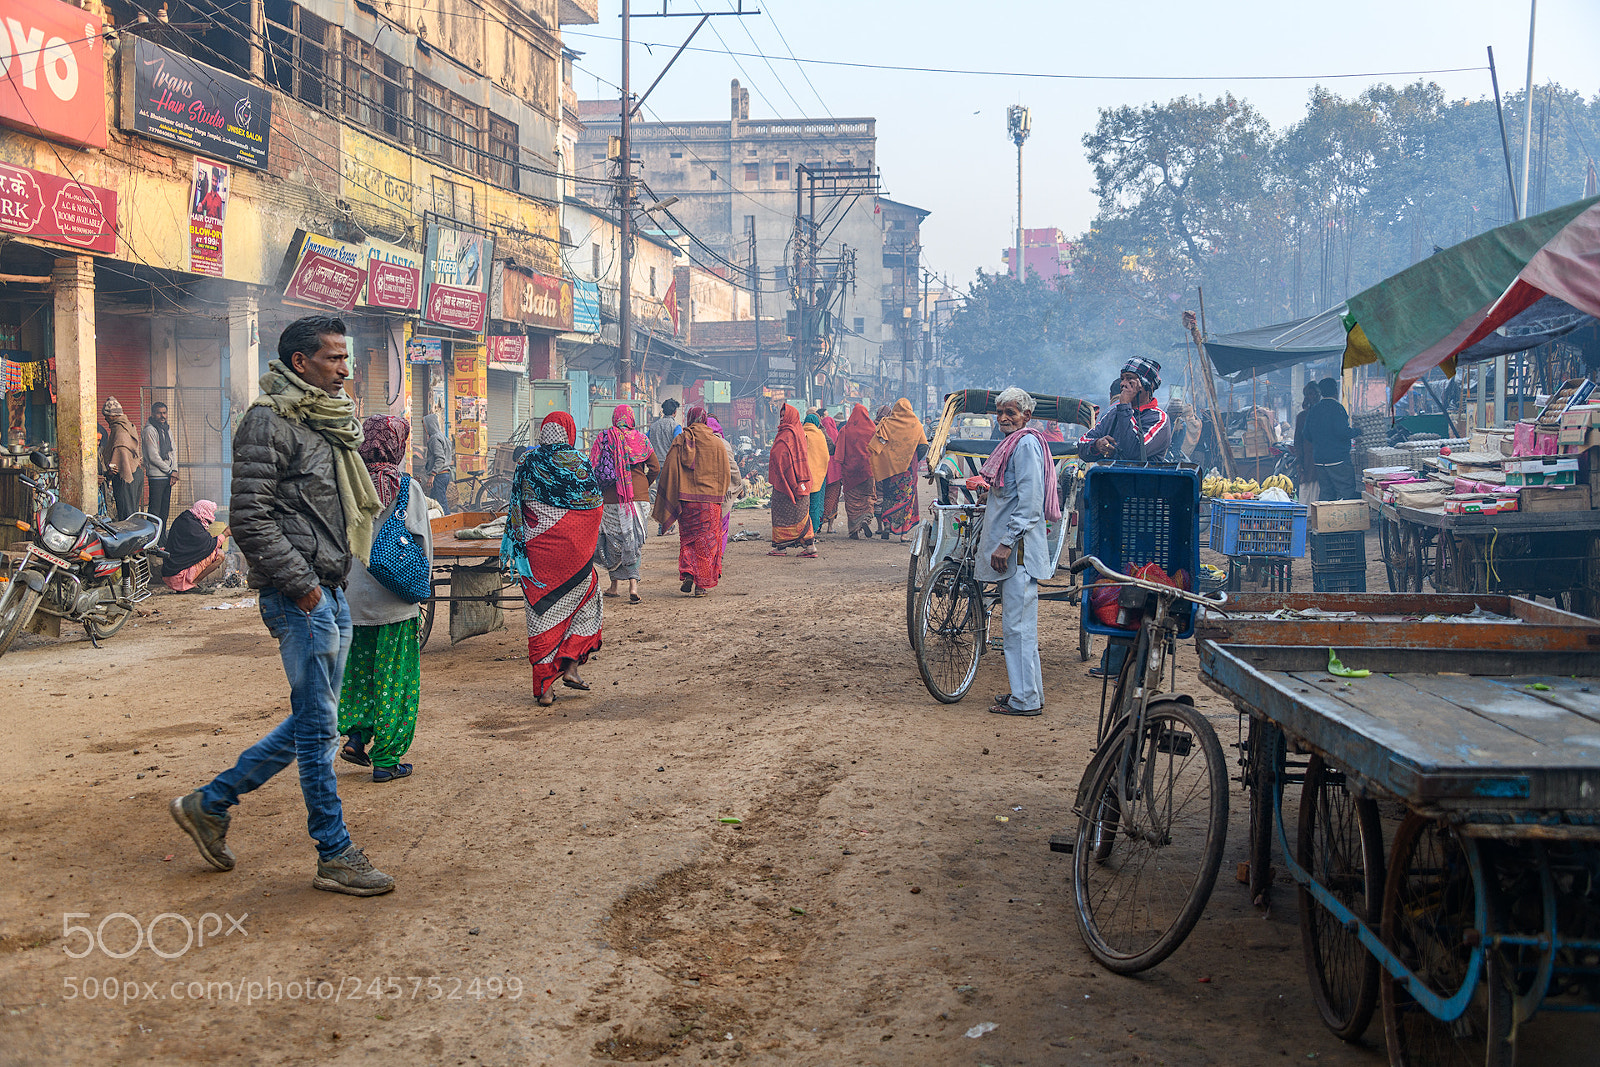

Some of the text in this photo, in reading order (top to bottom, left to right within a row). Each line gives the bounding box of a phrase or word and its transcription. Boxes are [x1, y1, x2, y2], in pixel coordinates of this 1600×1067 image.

[143, 57, 193, 99] Trans
[149, 89, 225, 128] Hair Studio
[227, 124, 263, 143] UNISEX SALON
[58, 211, 101, 228] ROOMS AVAILABLE
[191, 213, 204, 222] HAIR
[189, 225, 222, 239] BLOW-DRY
[438, 261, 458, 274] TIGER
[520, 282, 558, 318] Bata
